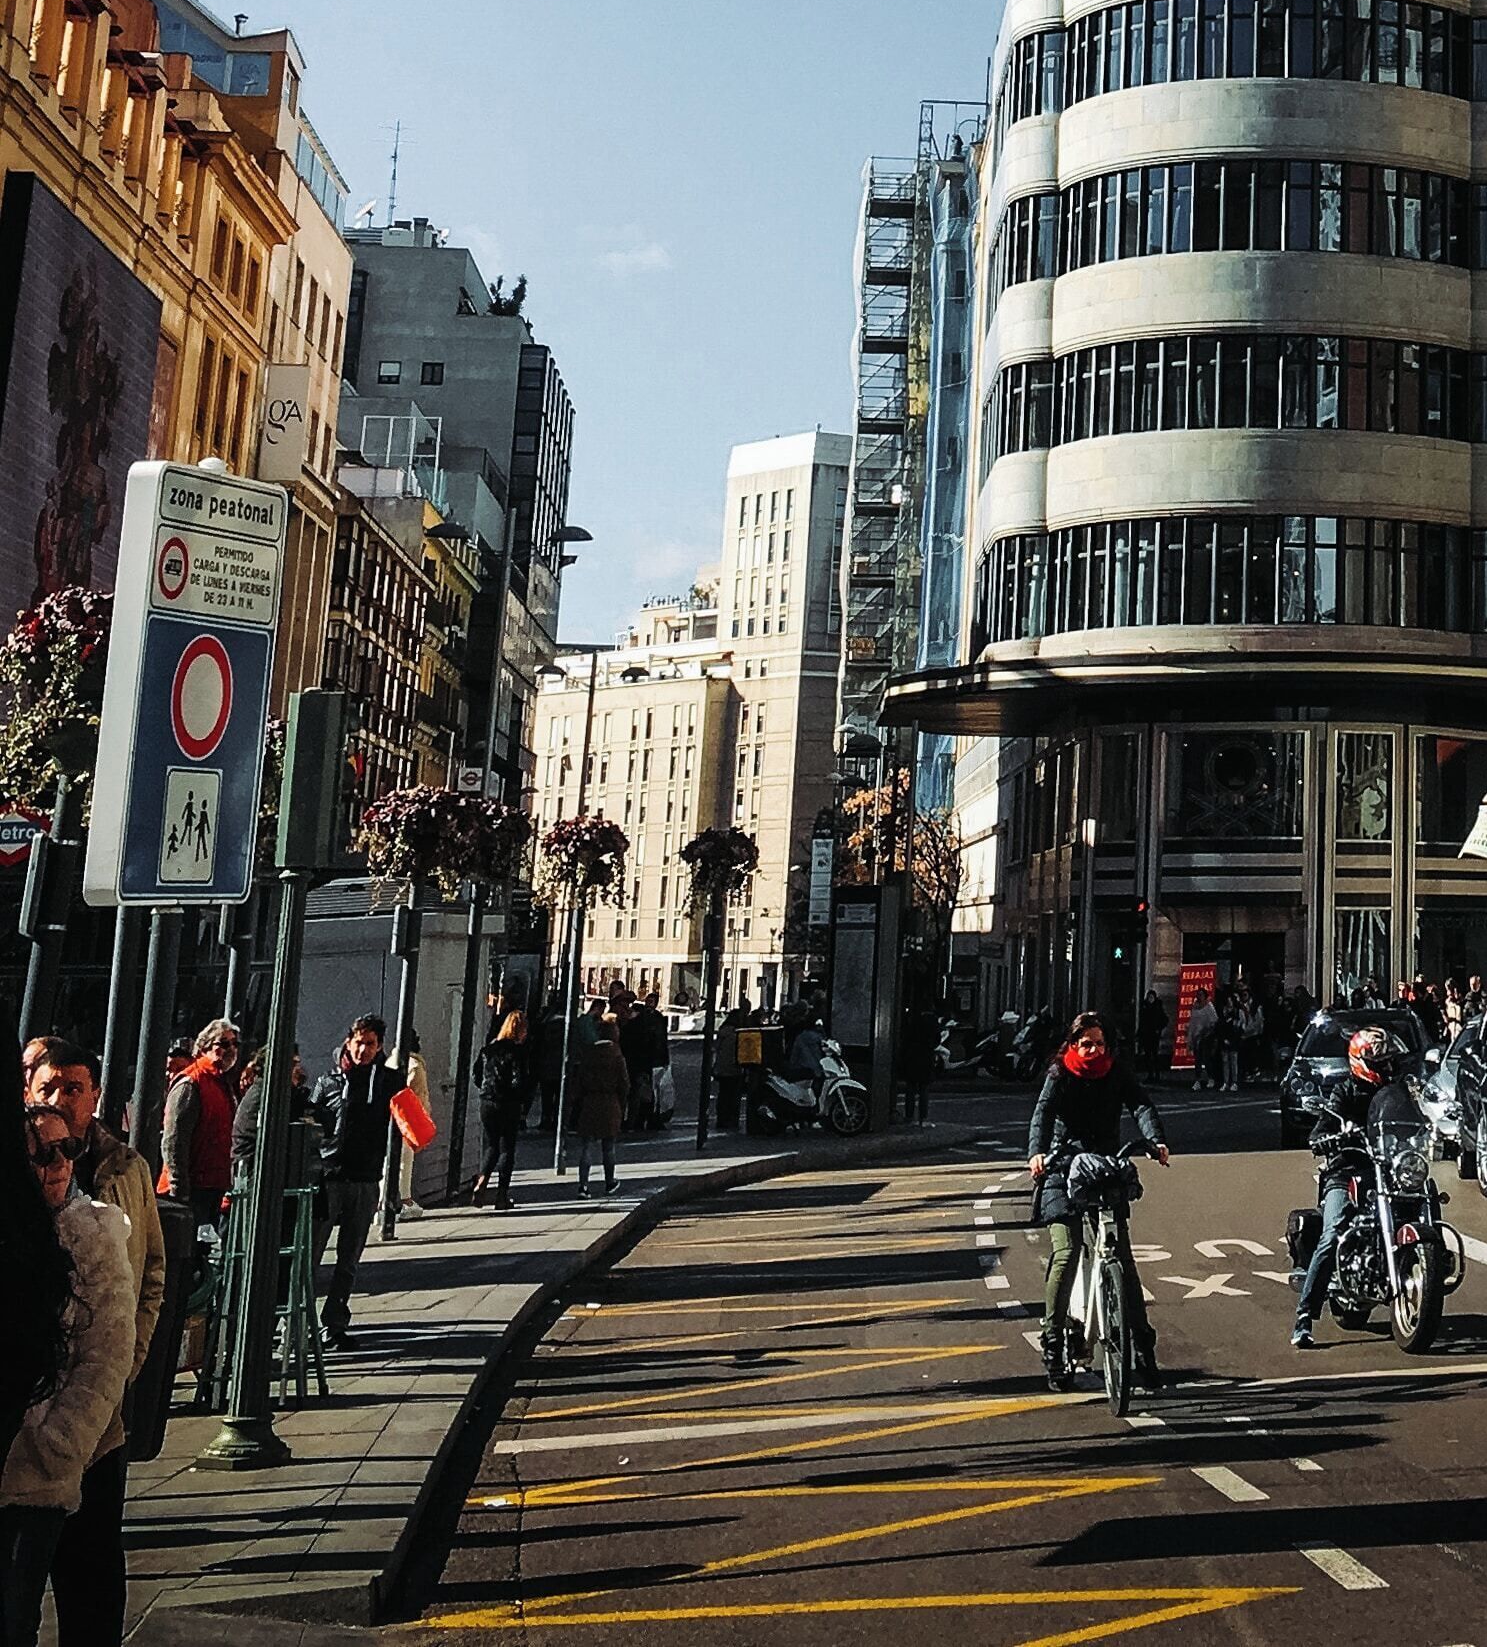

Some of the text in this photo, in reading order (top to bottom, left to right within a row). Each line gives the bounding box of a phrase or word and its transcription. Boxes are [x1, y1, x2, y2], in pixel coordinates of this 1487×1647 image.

[169, 487, 274, 526] zona peatonal
[214, 545, 254, 563] PERMITIDO
[193, 558, 271, 581] CARGA Y DESCARGA
[190, 574, 271, 597] DE LUNES A VIERNES
[203, 591, 215, 604] DE
[229, 596, 236, 606] A
[0, 825, 37, 841] etro
